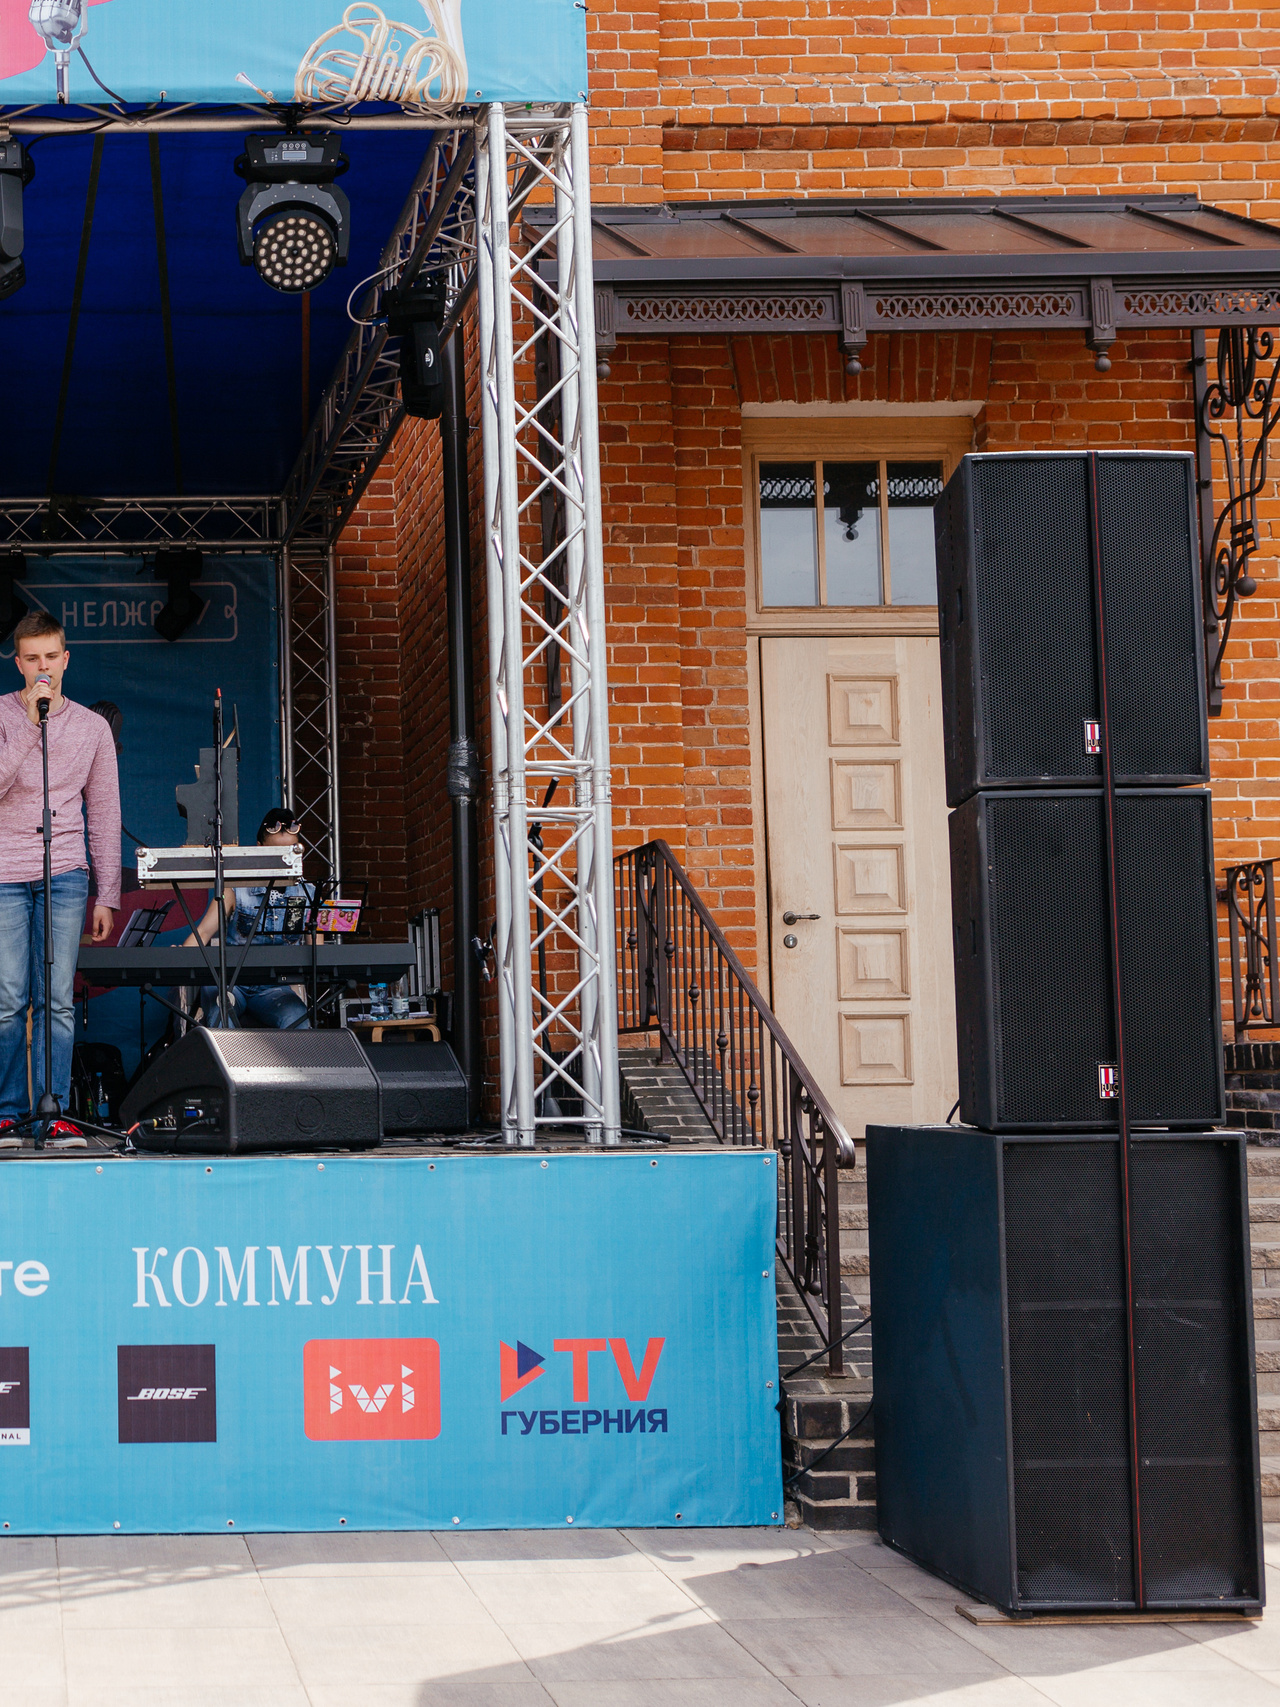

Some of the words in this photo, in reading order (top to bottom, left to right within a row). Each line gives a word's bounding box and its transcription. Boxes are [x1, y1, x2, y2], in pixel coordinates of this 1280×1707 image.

[132, 1244, 440, 1308] КОММУНА
[553, 1338, 666, 1402] TV
[127, 1387, 207, 1400] BOSE
[501, 1408, 668, 1436] ГУБЕРНИЯ
